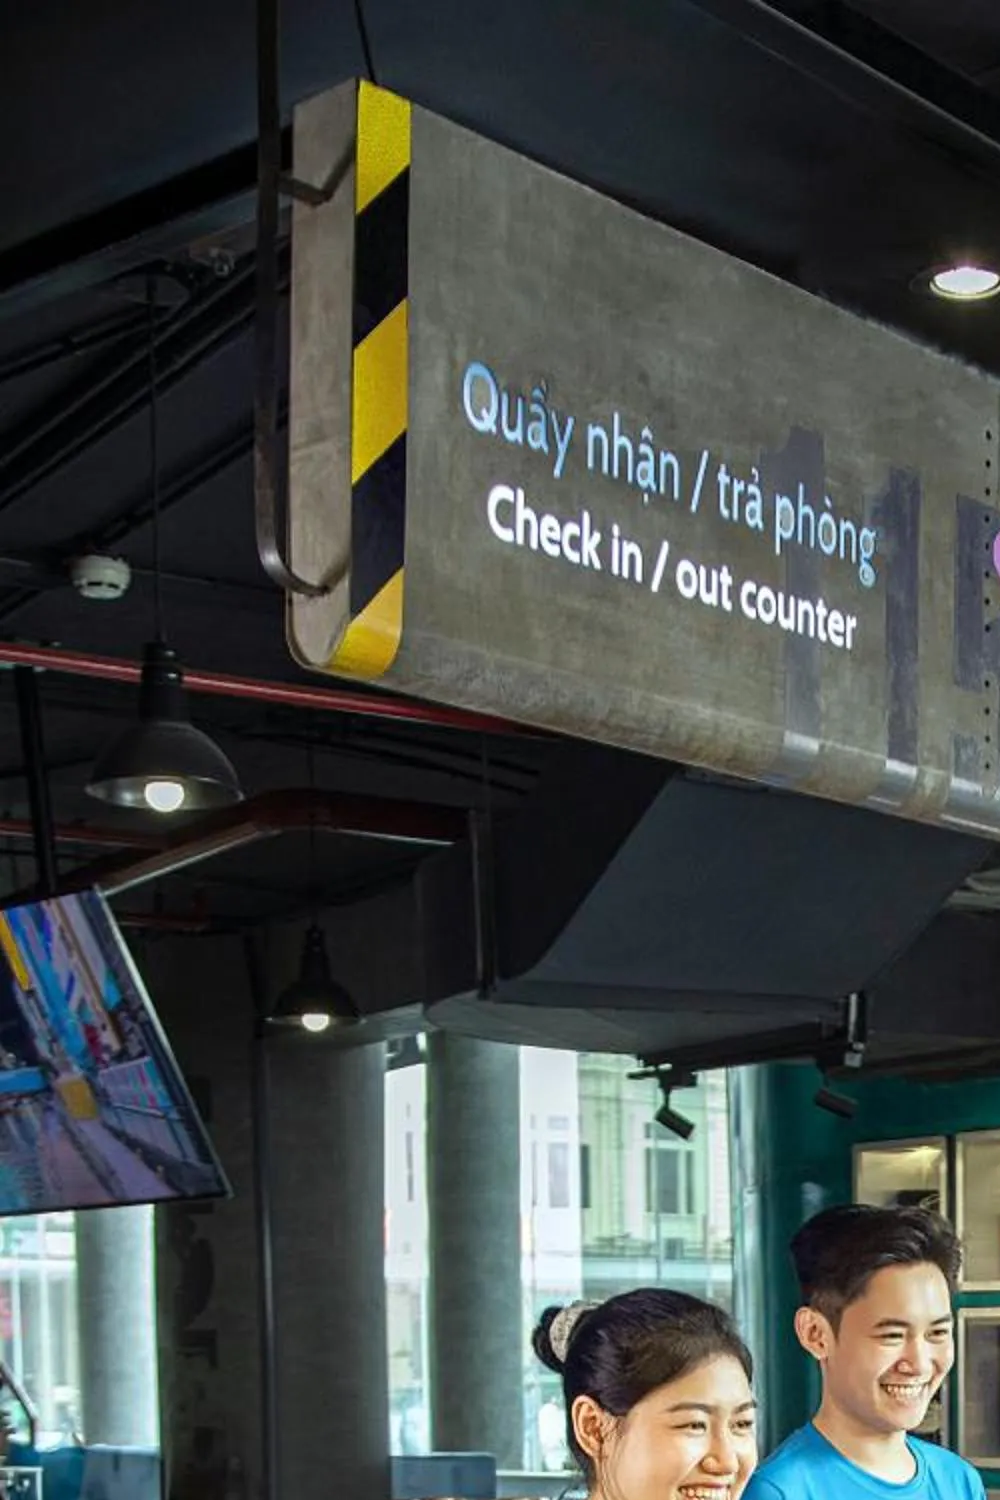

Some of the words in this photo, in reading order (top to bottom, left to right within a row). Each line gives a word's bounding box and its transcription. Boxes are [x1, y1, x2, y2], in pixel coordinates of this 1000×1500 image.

[487, 484, 602, 570] Check
[611, 523, 643, 583] in
[651, 540, 668, 593] /
[675, 559, 733, 612] out
[740, 579, 857, 650] counter
[586, 412, 681, 503] nhận
[690, 450, 709, 512] /
[717, 463, 765, 532] trả
[774, 482, 877, 588] phòng
